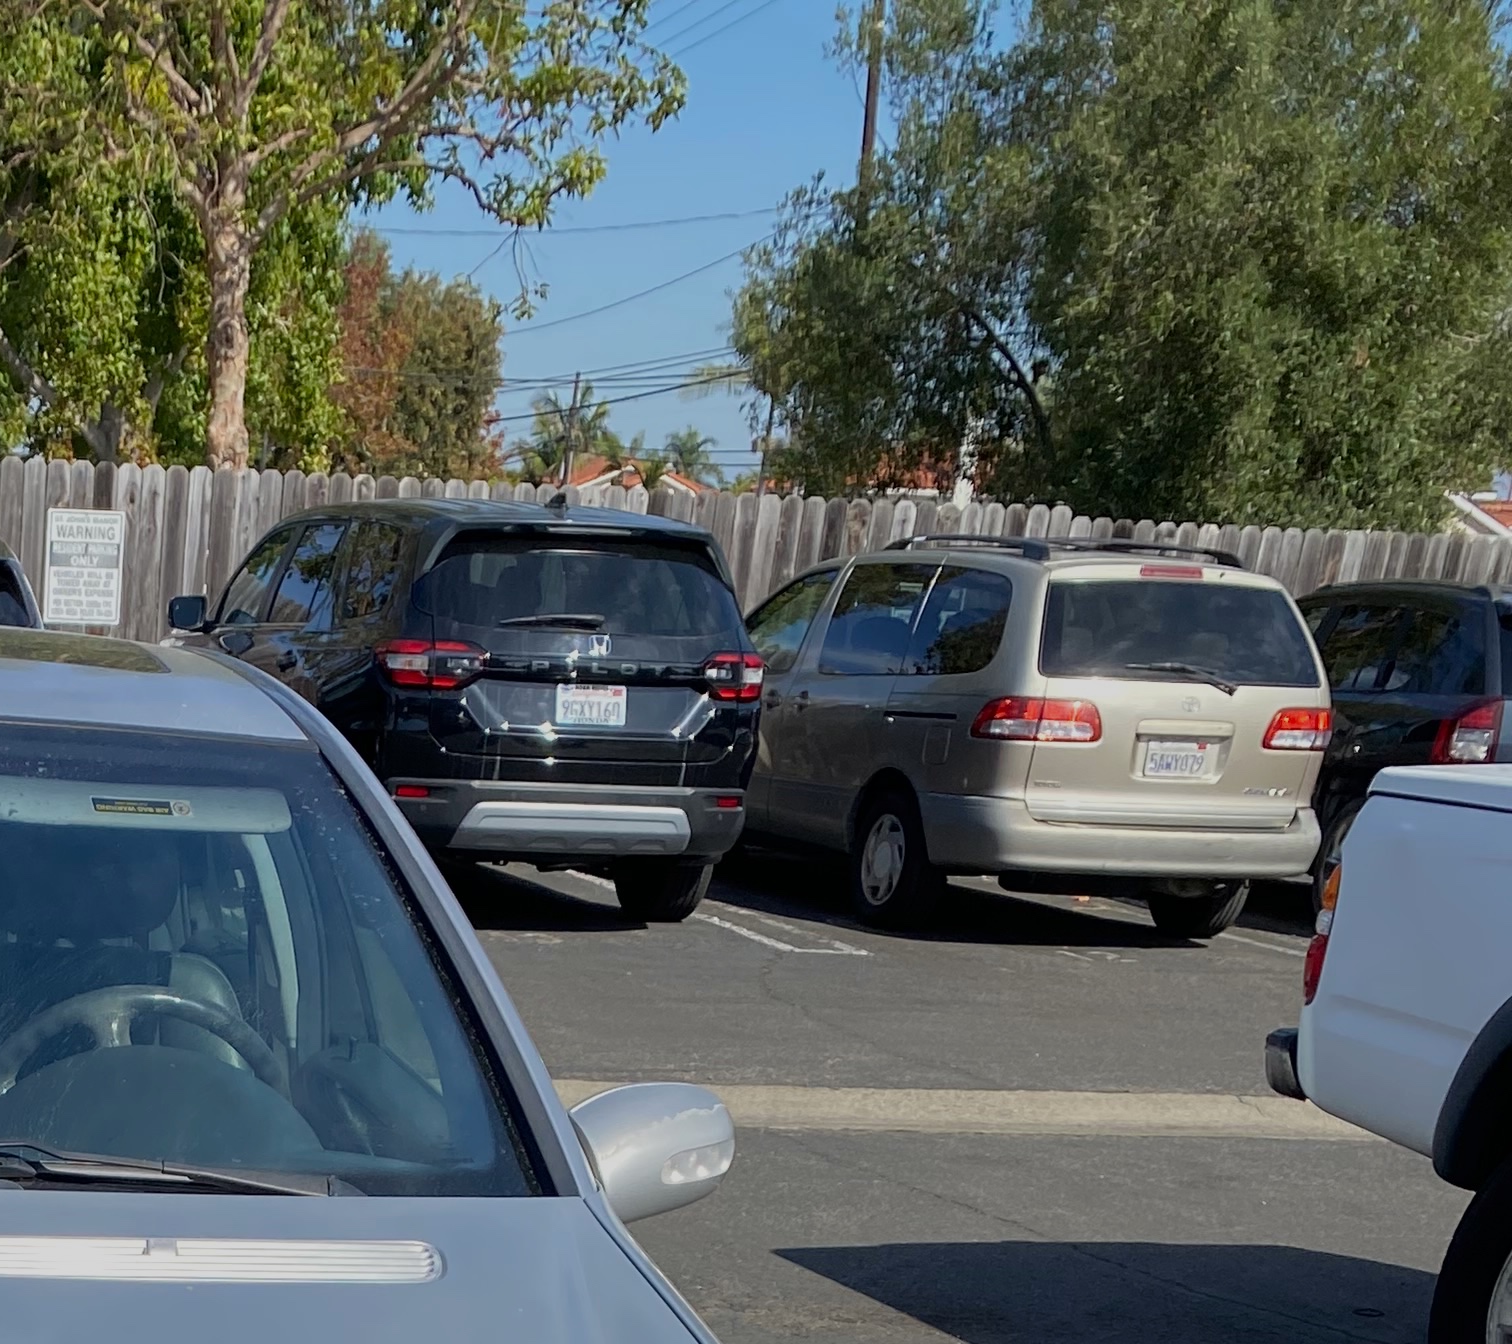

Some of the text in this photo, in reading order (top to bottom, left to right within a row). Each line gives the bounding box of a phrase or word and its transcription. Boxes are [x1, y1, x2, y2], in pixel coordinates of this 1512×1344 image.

[56, 524, 116, 541] WARNING
[52, 542, 118, 555] RESIDENT PARKING
[70, 554, 99, 567] ONLY
[53, 570, 84, 579] VEHICLES
[87, 571, 103, 579] WILL
[57, 578, 81, 587] TOWED
[82, 579, 101, 588] AWAY
[531, 659, 668, 677] PILOT
[1149, 752, 1204, 774] 5AWY079
